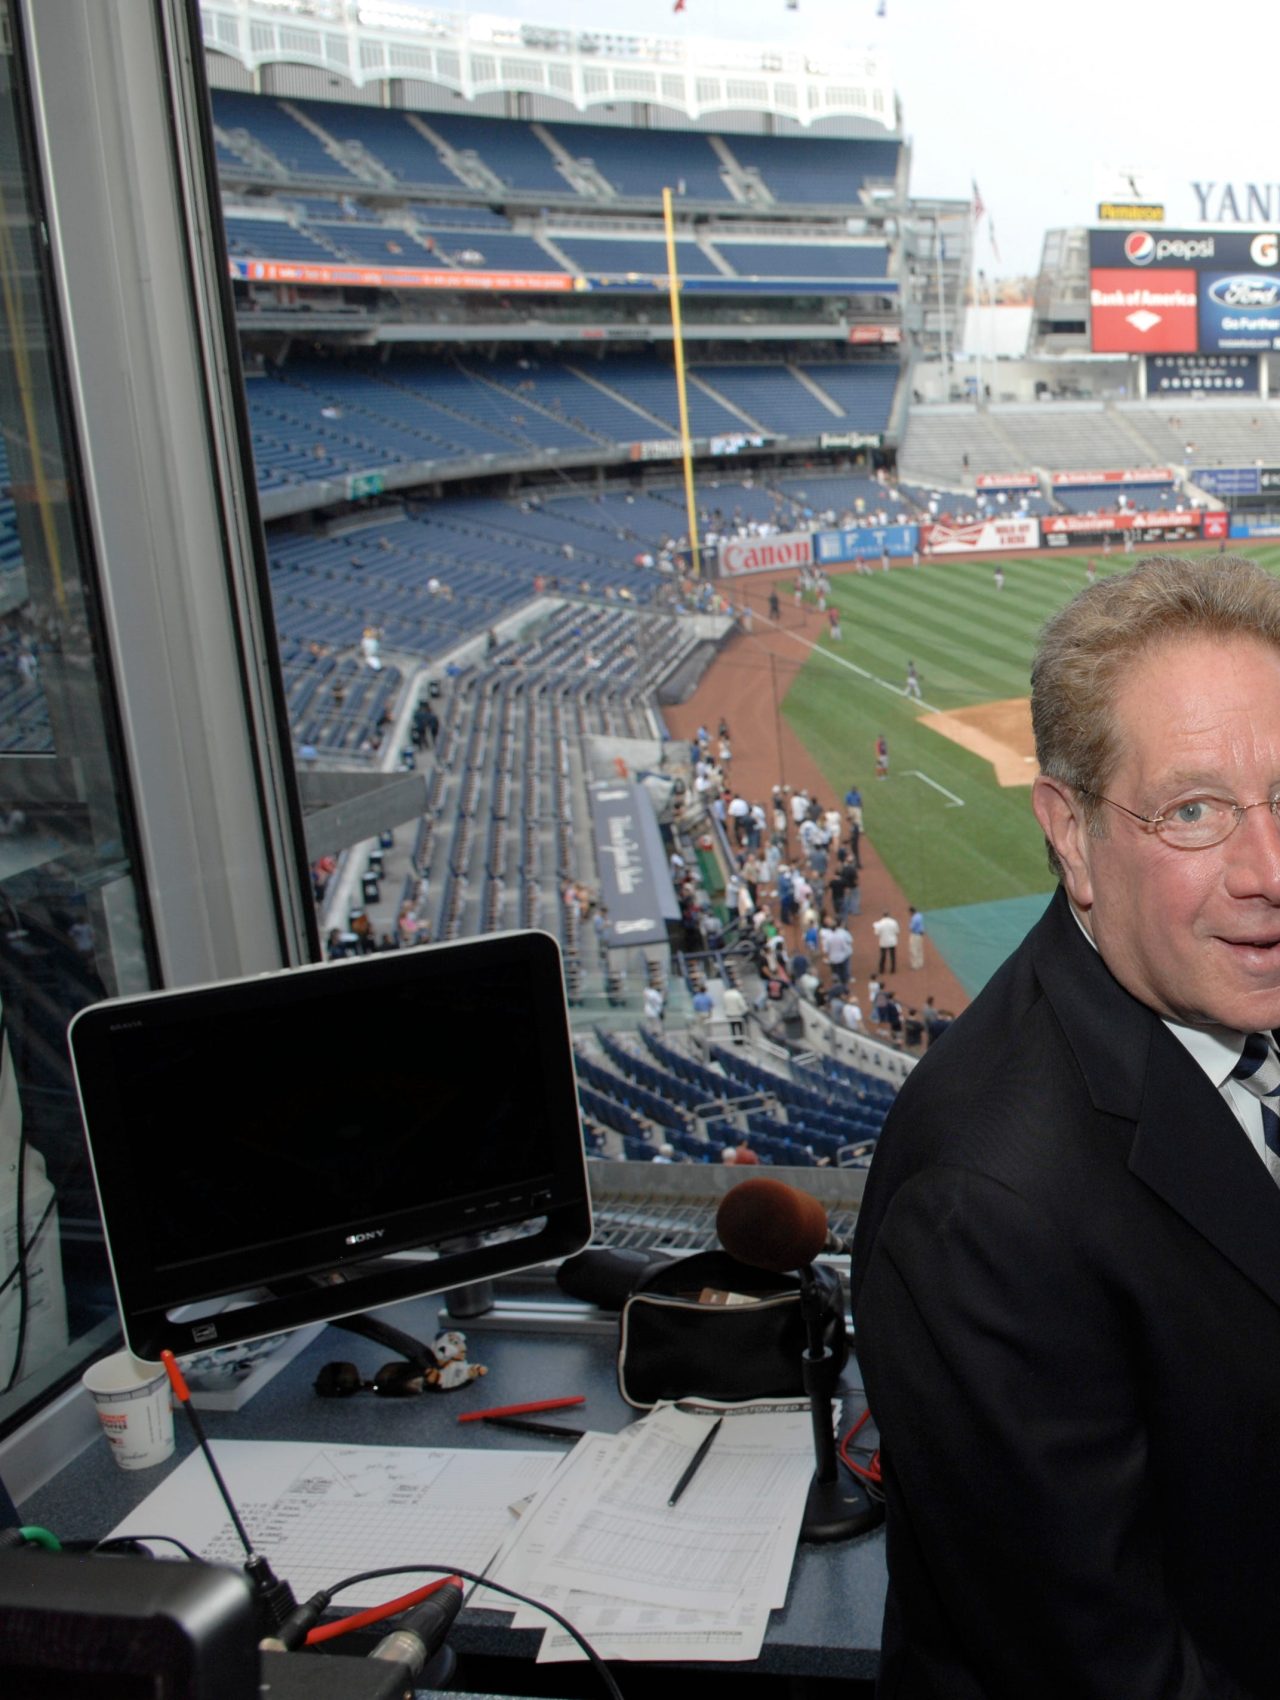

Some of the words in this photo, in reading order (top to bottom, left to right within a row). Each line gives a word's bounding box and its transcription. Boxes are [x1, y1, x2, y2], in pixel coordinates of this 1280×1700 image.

[1156, 237, 1215, 261] pepsi
[1251, 233, 1279, 267] G
[1091, 288, 1125, 307] Bank
[1125, 288, 1140, 307] of
[1141, 288, 1198, 307] America
[1224, 279, 1279, 305] Ford
[1221, 316, 1240, 331] Go
[723, 541, 811, 572] Canon
[345, 1228, 385, 1245] SONY
[724, 1406, 773, 1417] BOSTON
[775, 1404, 800, 1413] RED
